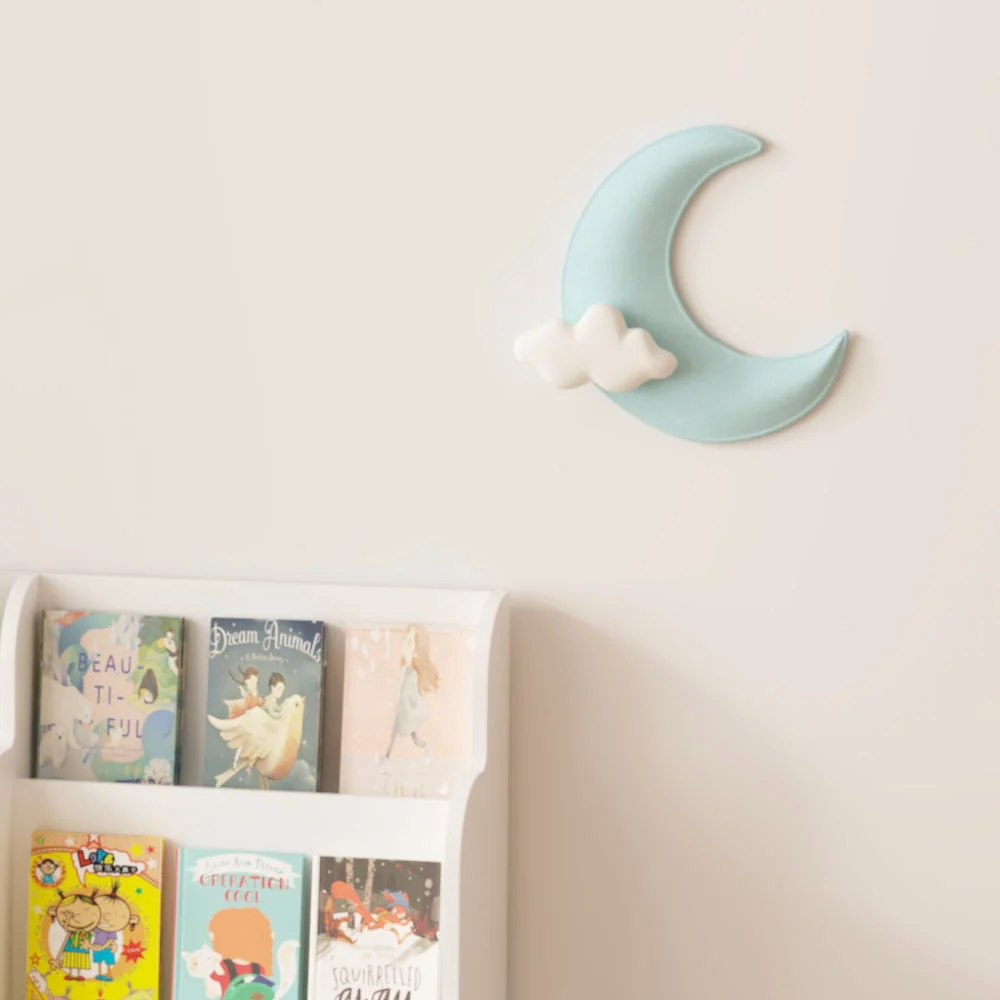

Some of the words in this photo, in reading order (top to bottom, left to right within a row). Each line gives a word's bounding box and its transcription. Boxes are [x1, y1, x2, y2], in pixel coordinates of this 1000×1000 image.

[209, 621, 259, 659] Dream
[262, 619, 321, 662] Animals
[78, 652, 144, 675] BEAU-
[94, 684, 124, 705] TI-
[107, 717, 143, 739] FUL
[199, 873, 291, 892] OPERATION
[224, 889, 261, 904] COOL
